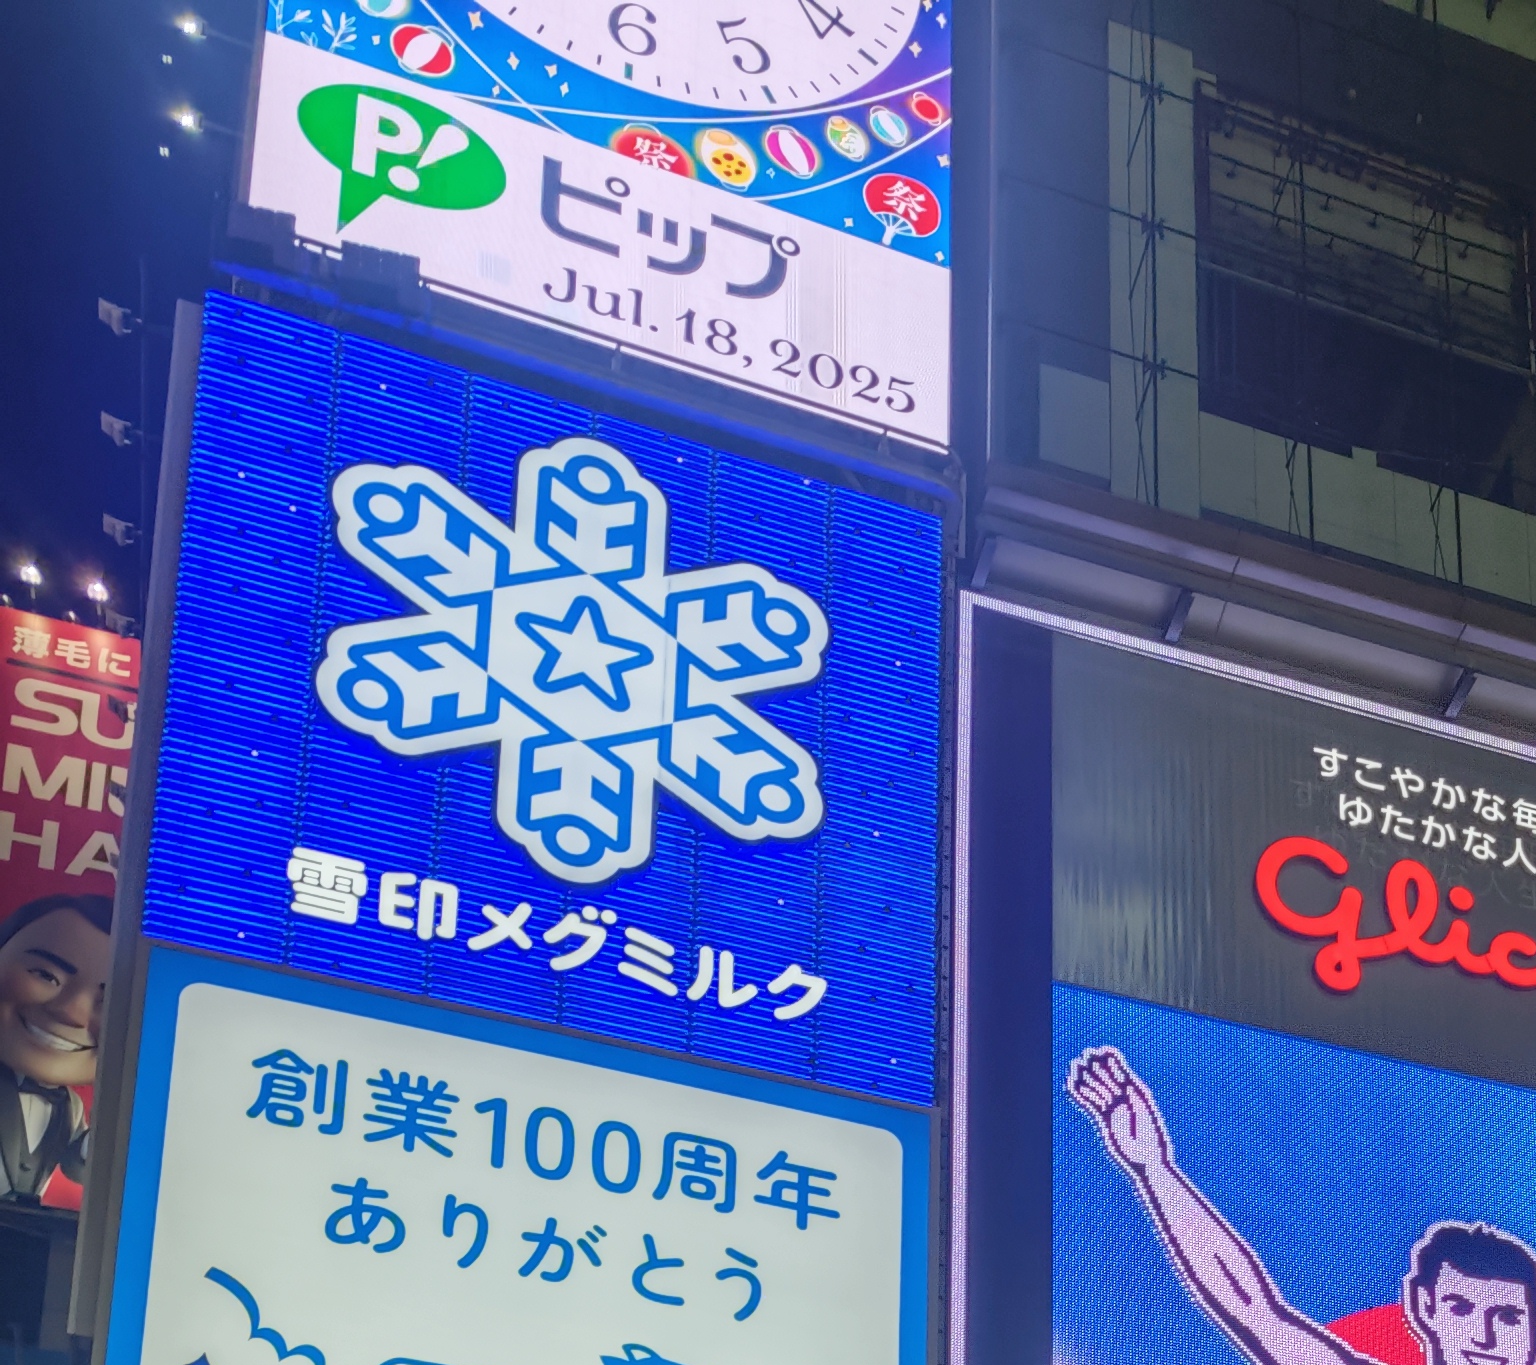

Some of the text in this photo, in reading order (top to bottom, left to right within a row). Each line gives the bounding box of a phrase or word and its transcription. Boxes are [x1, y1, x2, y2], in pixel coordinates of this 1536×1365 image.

[540, 154, 802, 301] ピップ
[882, 179, 928, 222] 祭
[541, 266, 918, 415] Jul. 18, 2025
[12, 625, 131, 678] 薄毛に
[285, 846, 830, 1021] 雪印メグミルク
[245, 1047, 843, 1232] 創業100周年
[321, 1177, 764, 1323] ありがとう
